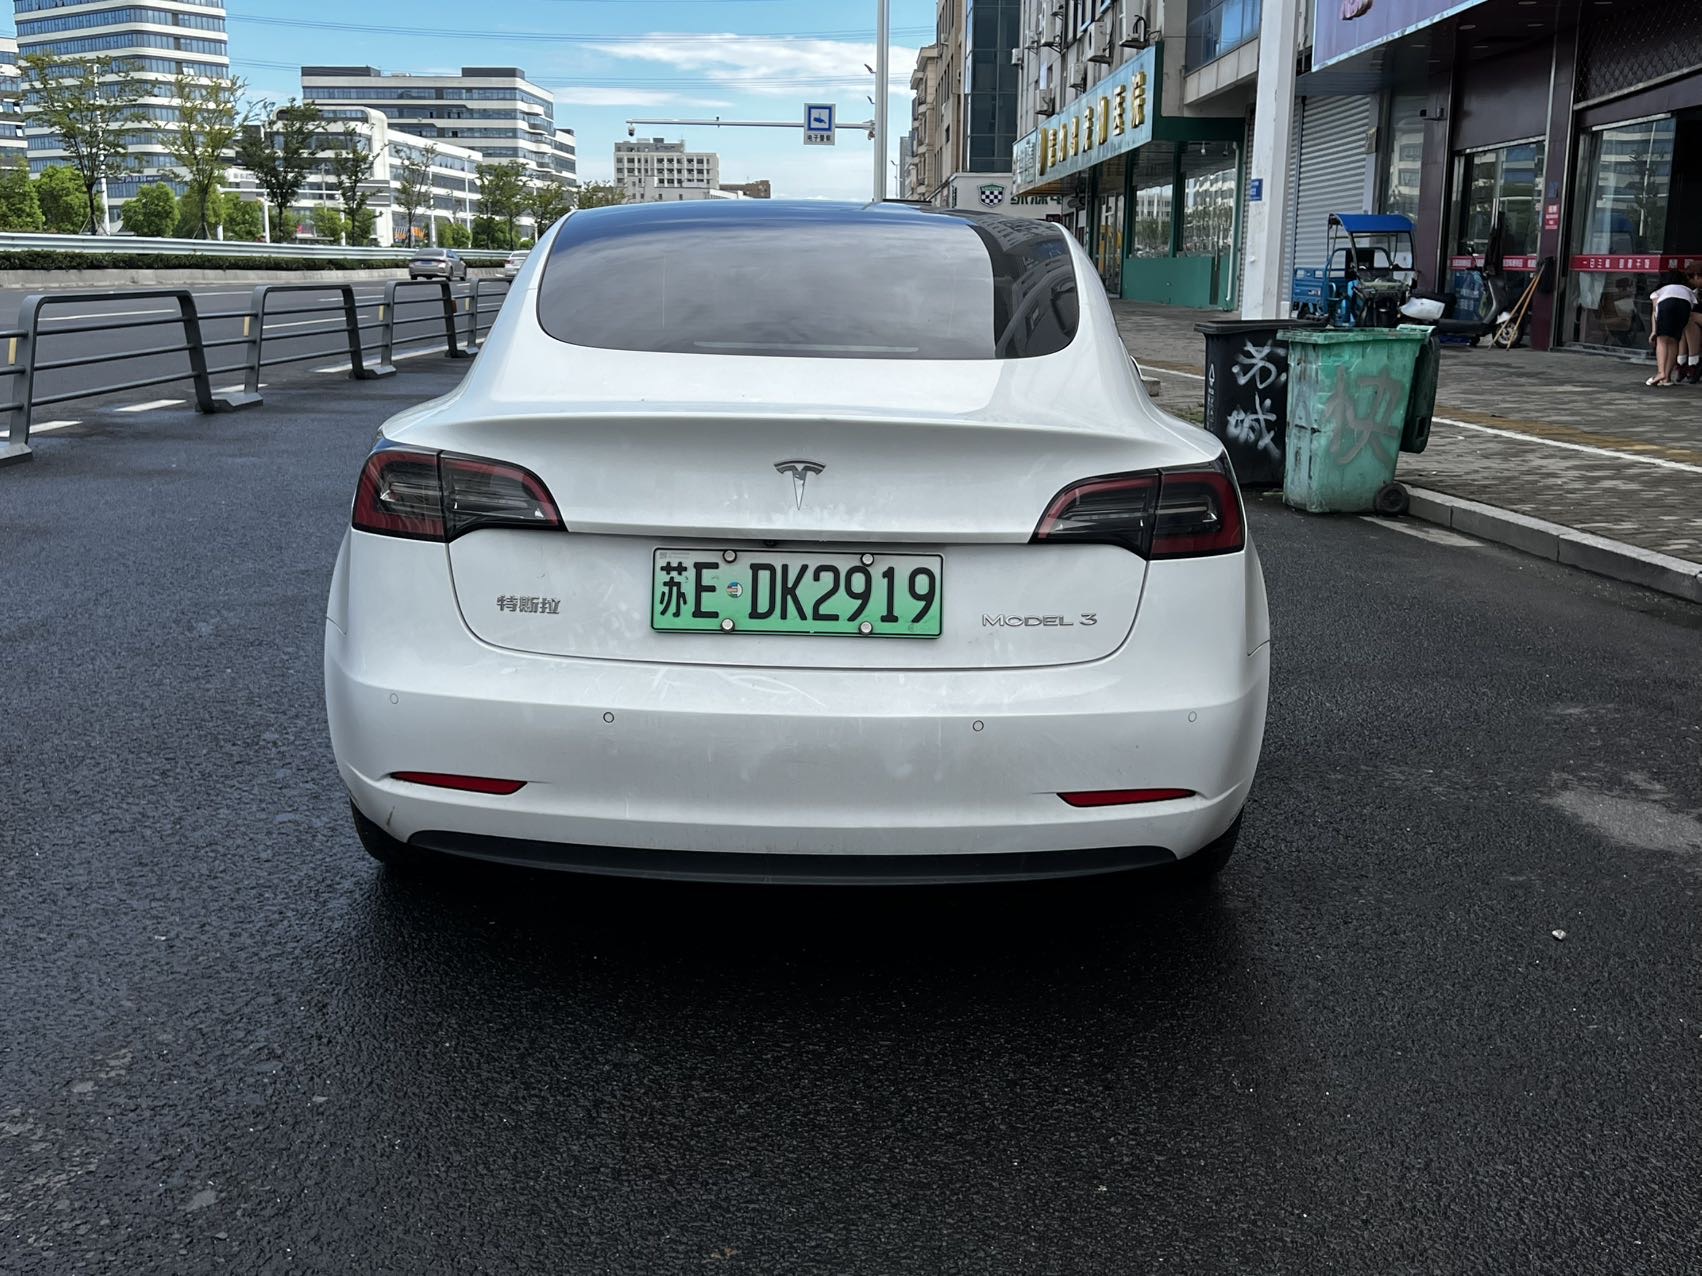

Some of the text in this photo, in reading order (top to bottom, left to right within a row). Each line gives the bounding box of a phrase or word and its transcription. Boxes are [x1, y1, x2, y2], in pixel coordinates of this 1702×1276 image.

[496, 595, 561, 615] 特斯拉
[982, 613, 1097, 627] MODEL 3
